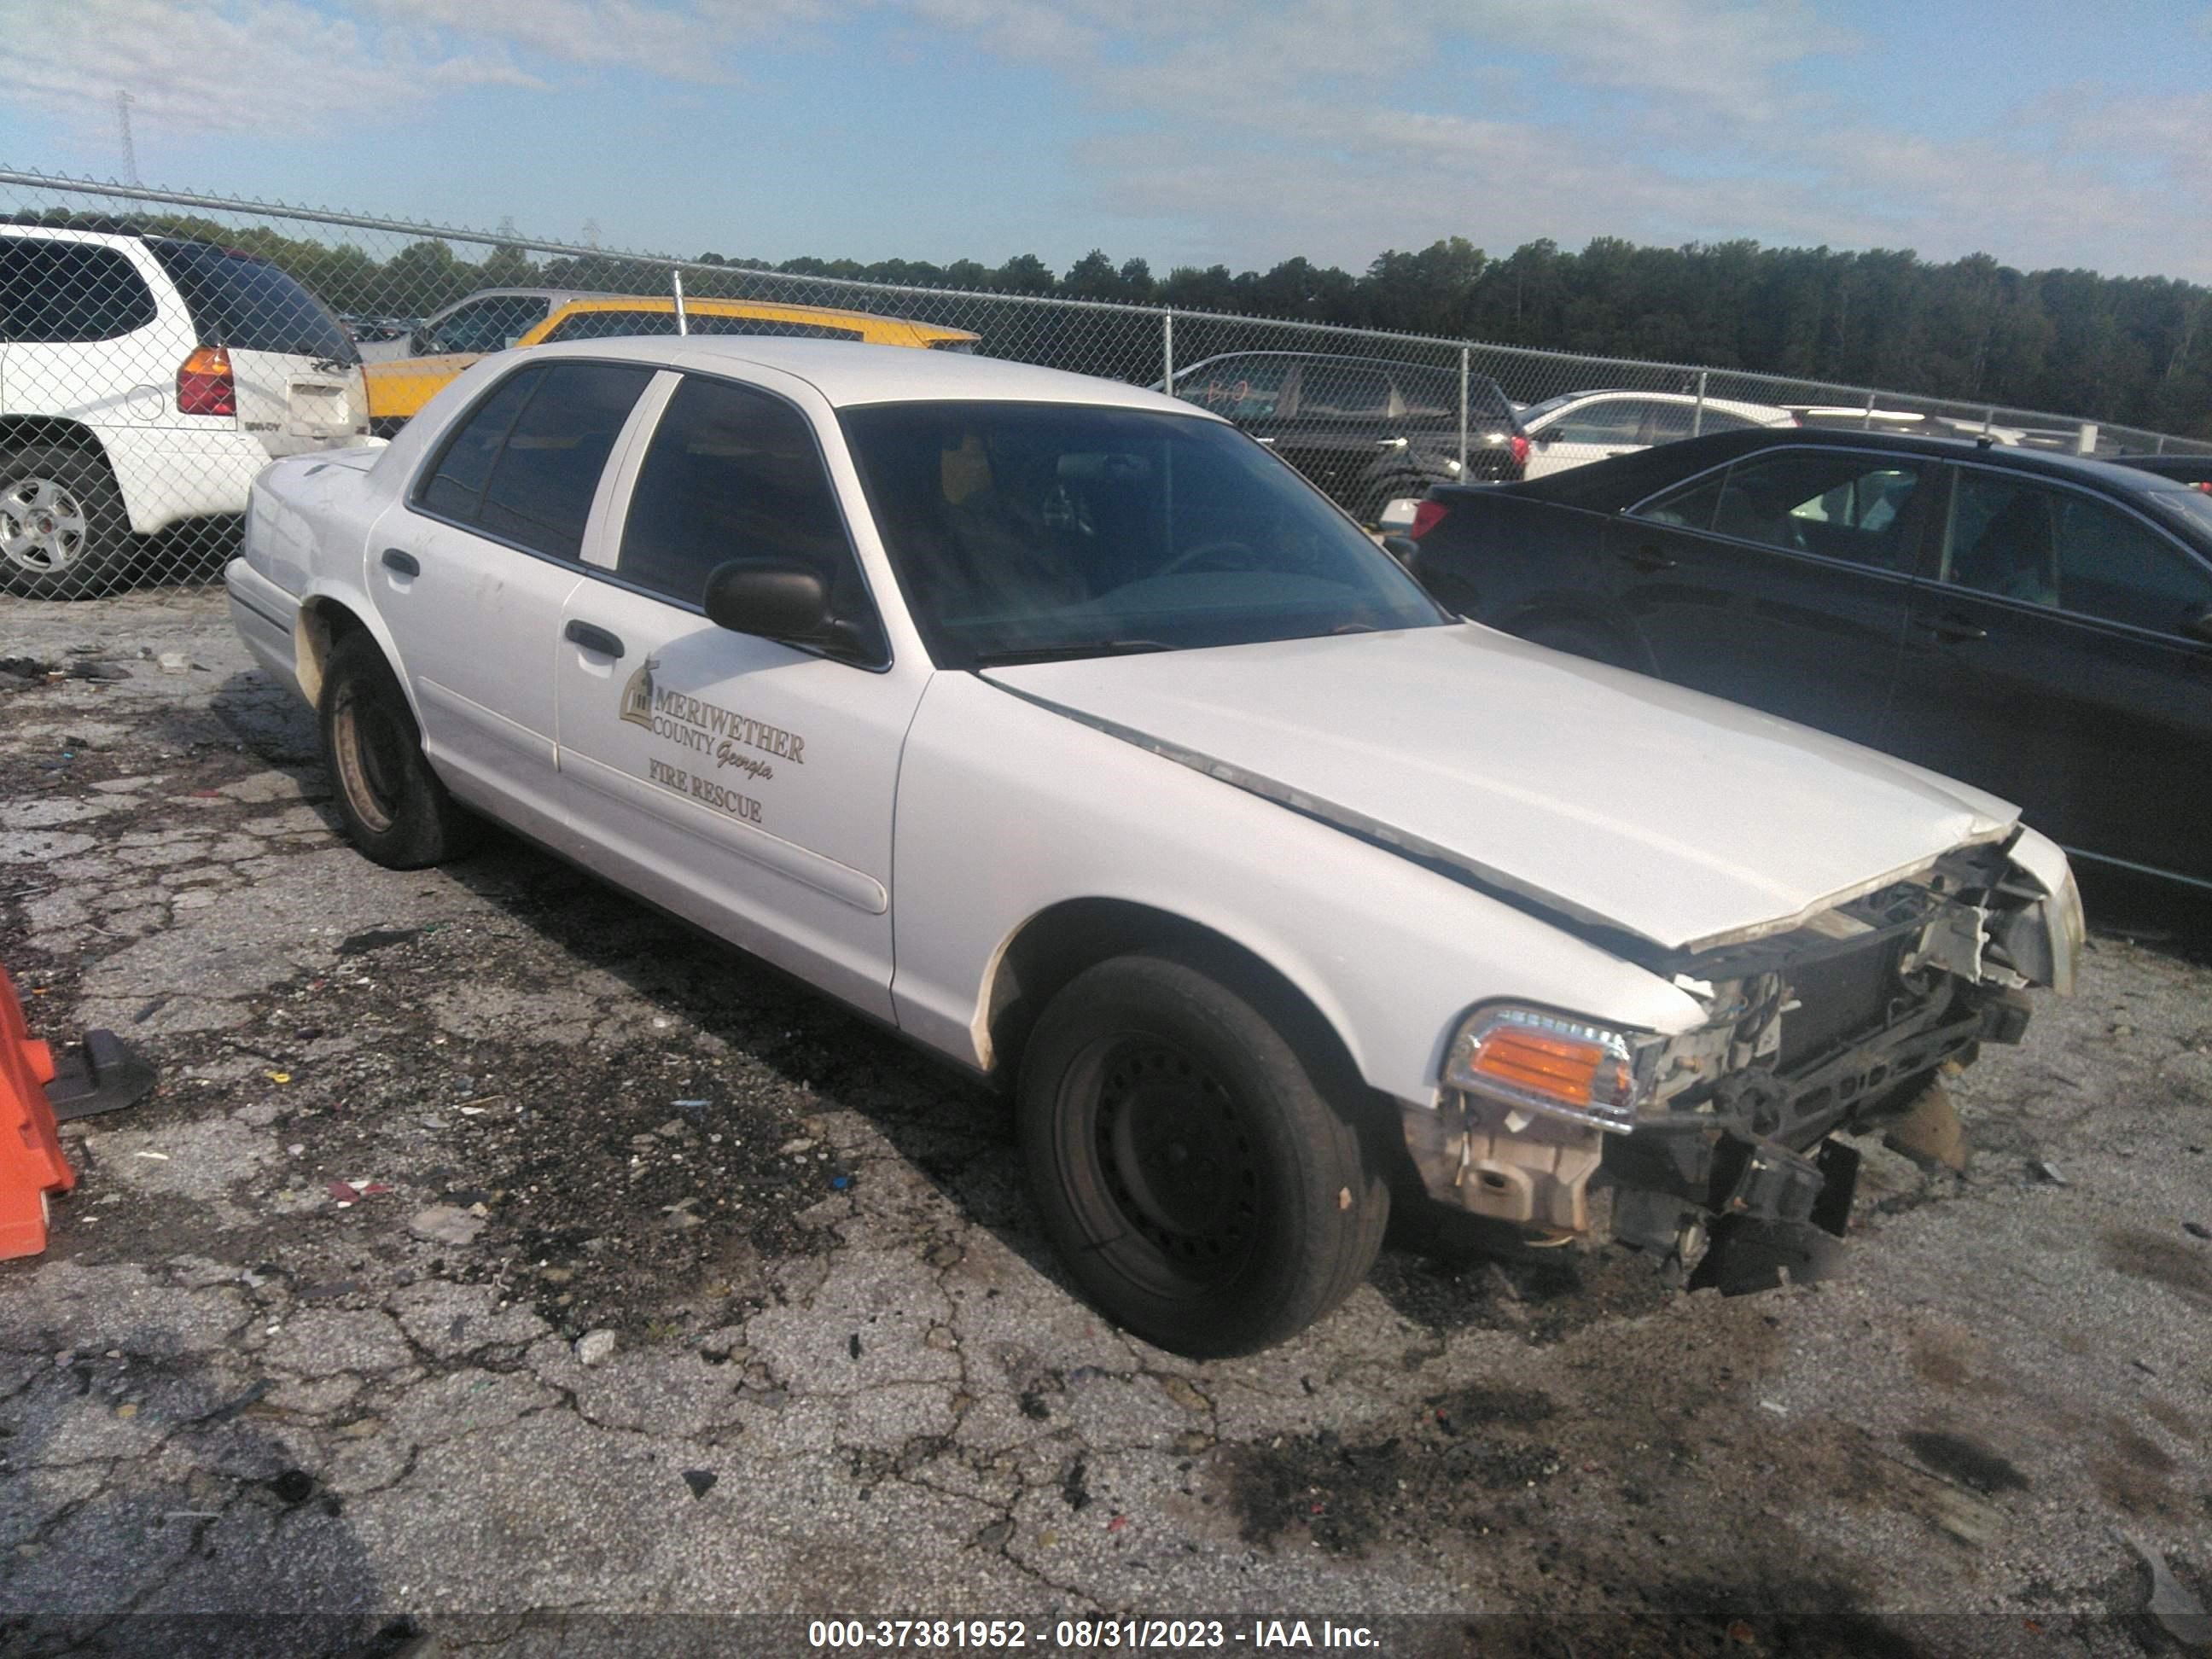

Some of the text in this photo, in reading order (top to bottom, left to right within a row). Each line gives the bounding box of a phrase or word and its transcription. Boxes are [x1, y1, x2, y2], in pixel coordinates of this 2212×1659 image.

[653, 716, 774, 780] COUNTY Georgia
[655, 685, 805, 765] MERIWETHER
[649, 757, 762, 824] FIRE RESCUE
